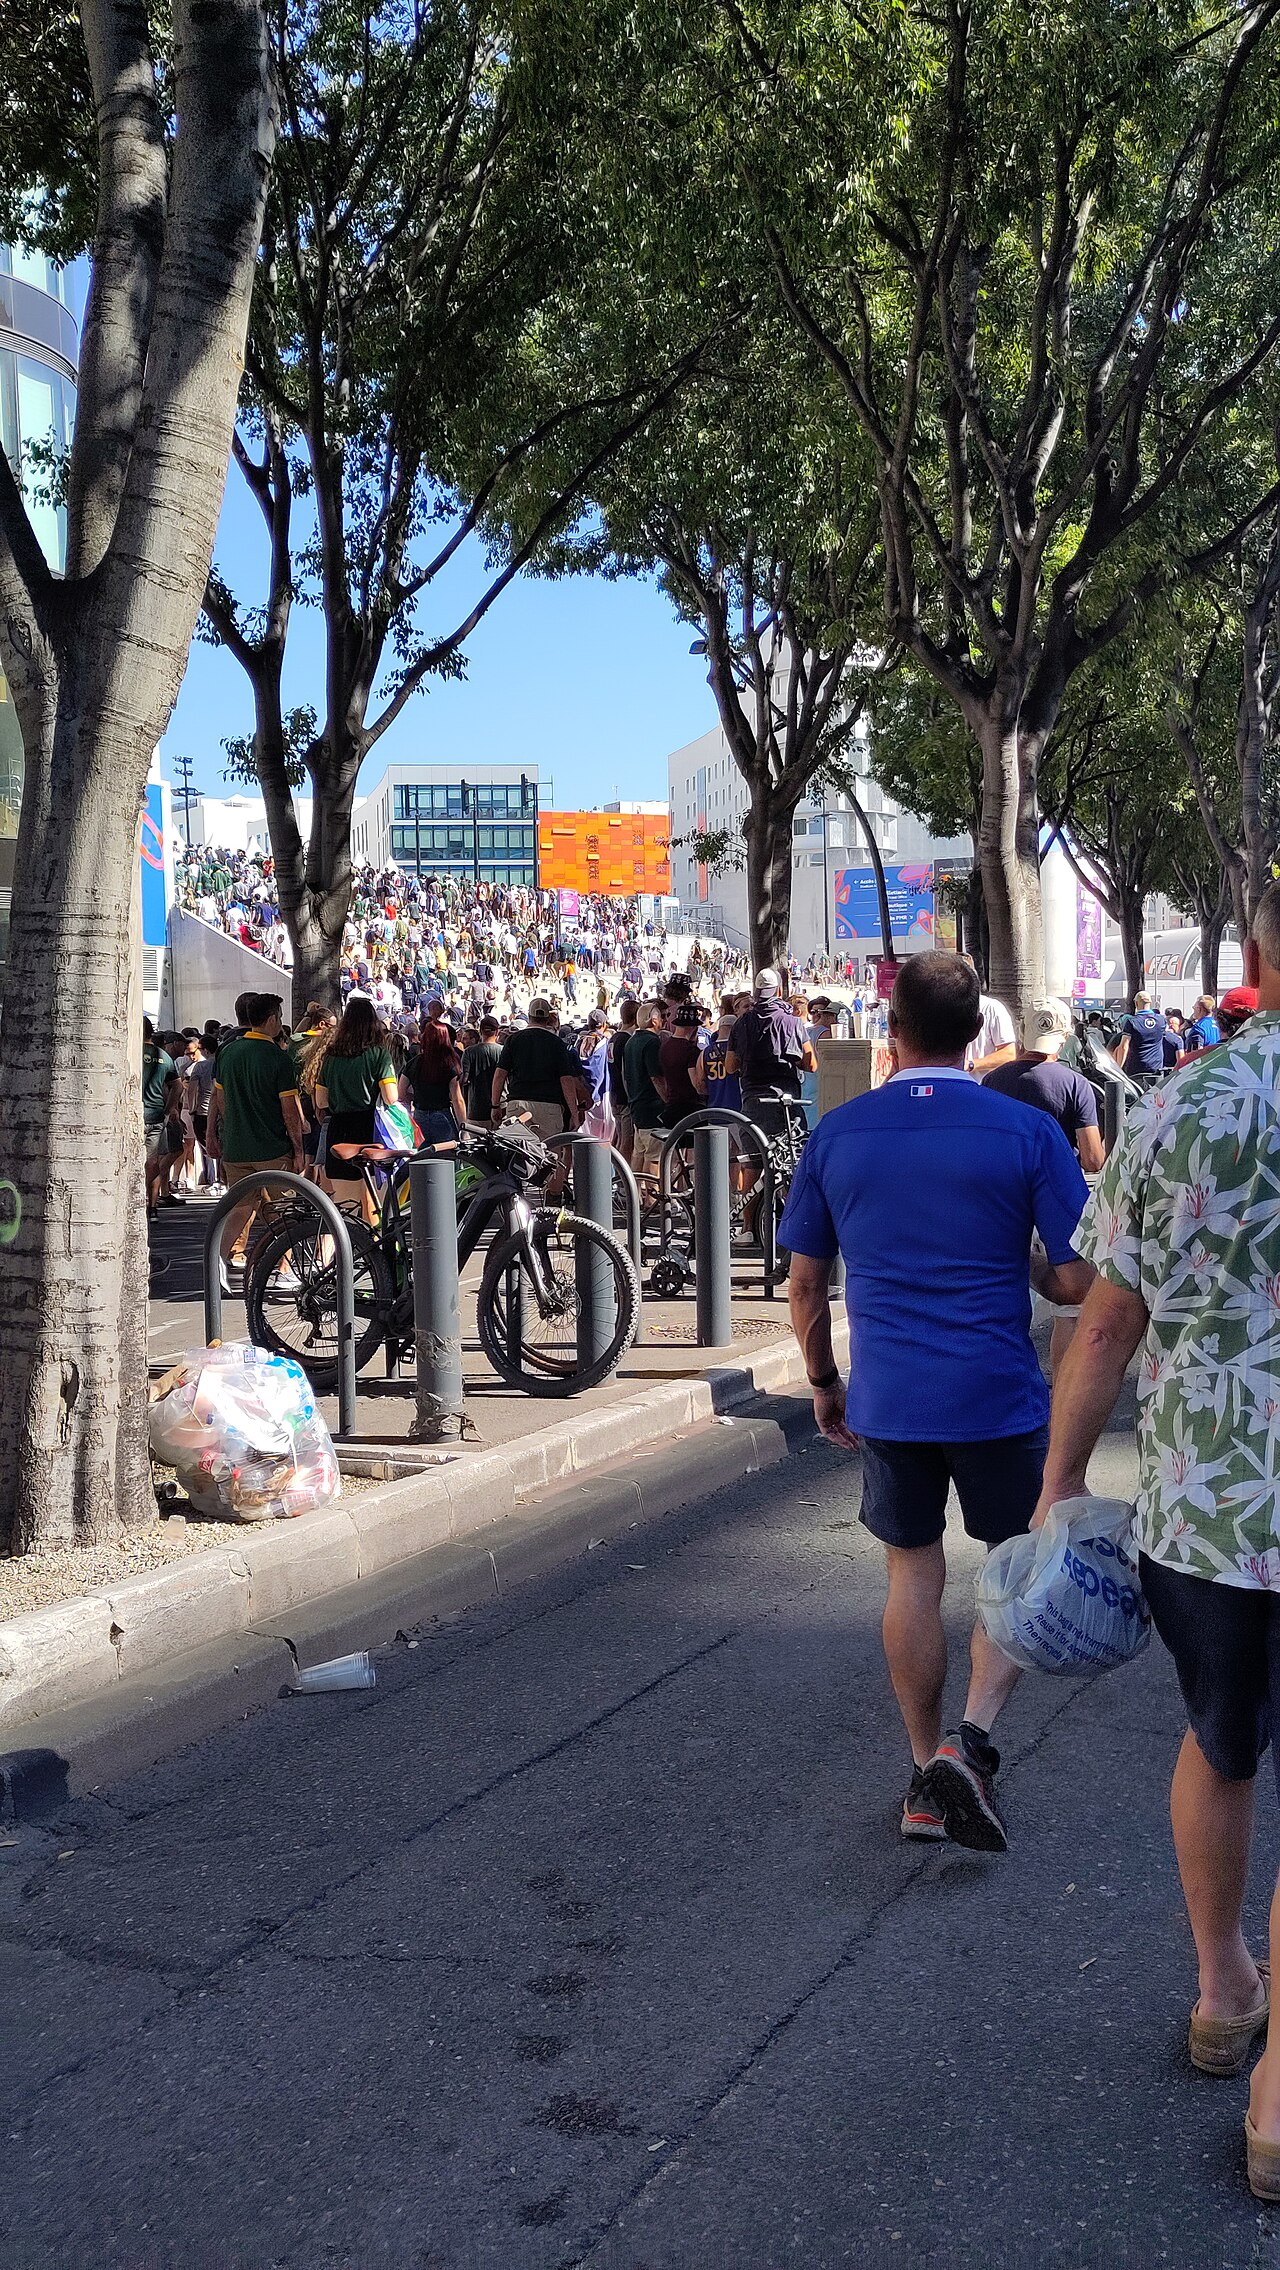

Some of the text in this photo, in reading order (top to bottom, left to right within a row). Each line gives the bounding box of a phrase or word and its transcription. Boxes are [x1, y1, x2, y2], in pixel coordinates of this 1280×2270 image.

[707, 1061, 726, 1080] 30
[1046, 1600, 1059, 1618] This
[1022, 1619, 1043, 1643] Then
